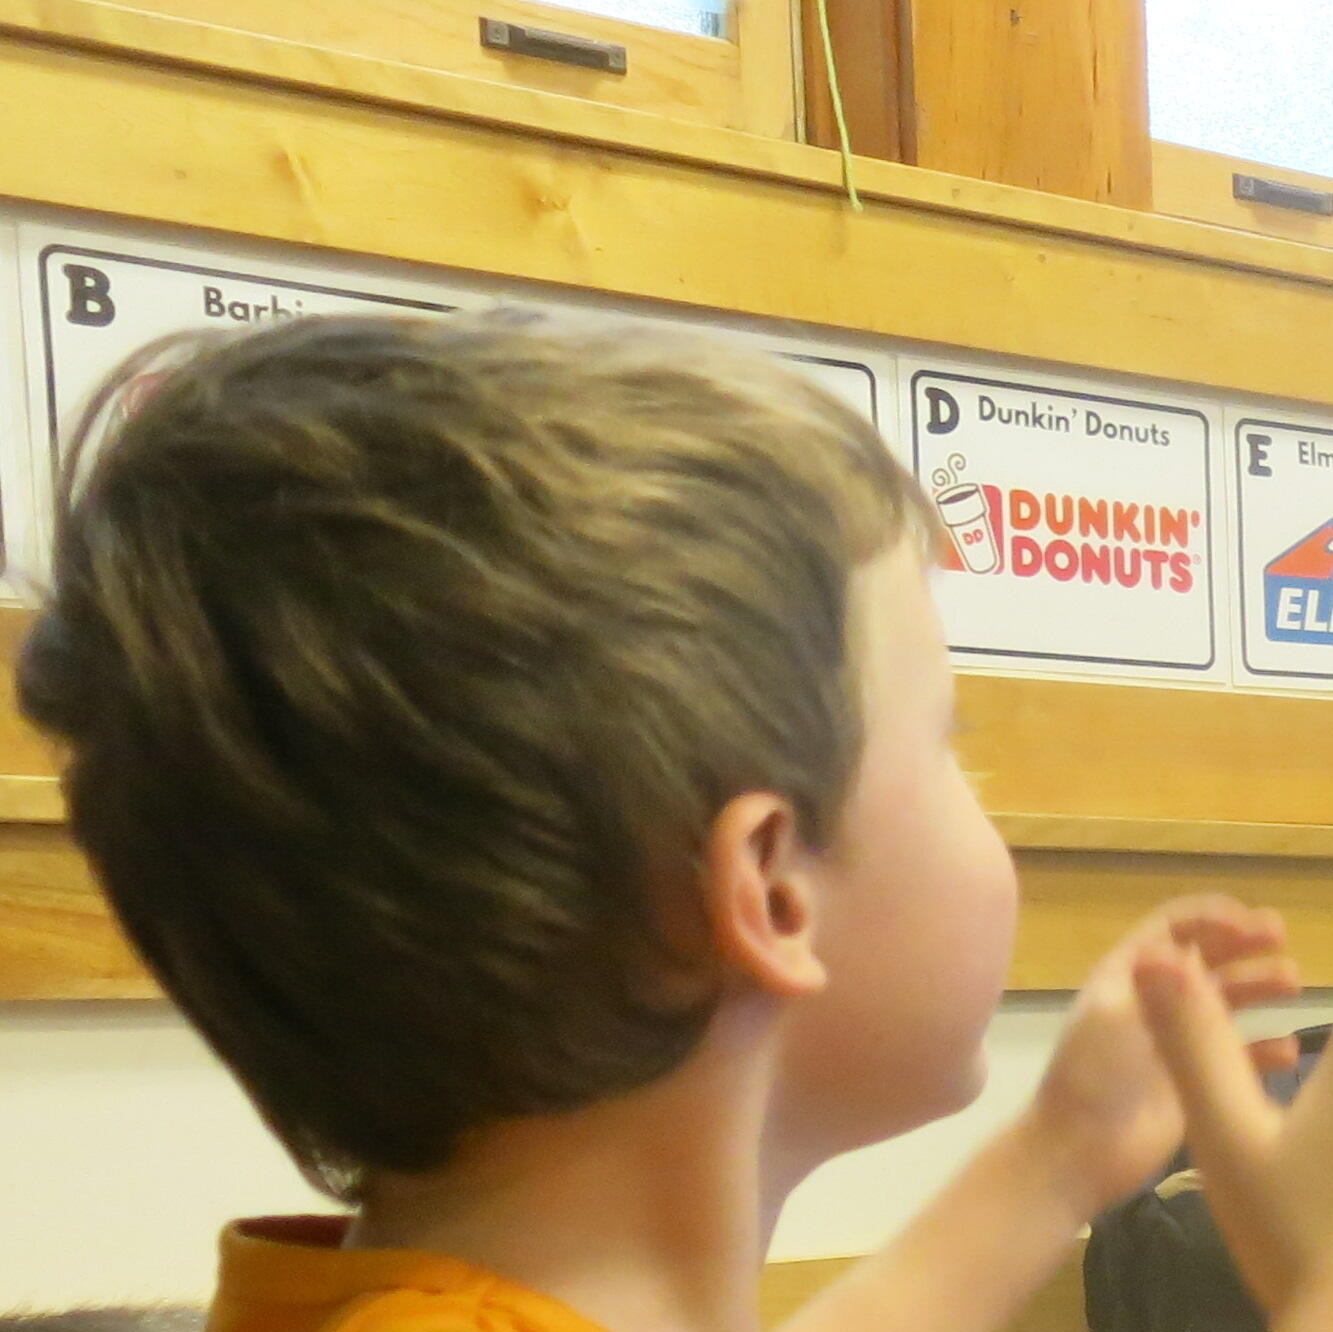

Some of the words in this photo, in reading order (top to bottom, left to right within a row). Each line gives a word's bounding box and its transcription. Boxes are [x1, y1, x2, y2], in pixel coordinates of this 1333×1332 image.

[63, 263, 116, 328] B
[203, 285, 304, 324] Barbi
[924, 386, 960, 435] D
[978, 394, 1078, 433] Dunkin'
[1085, 409, 1171, 447] Donuts
[1246, 433, 1273, 477] E
[962, 528, 984, 546] DD
[1009, 488, 1200, 548] DUNKIN'
[1011, 535, 1194, 593] DONUTS
